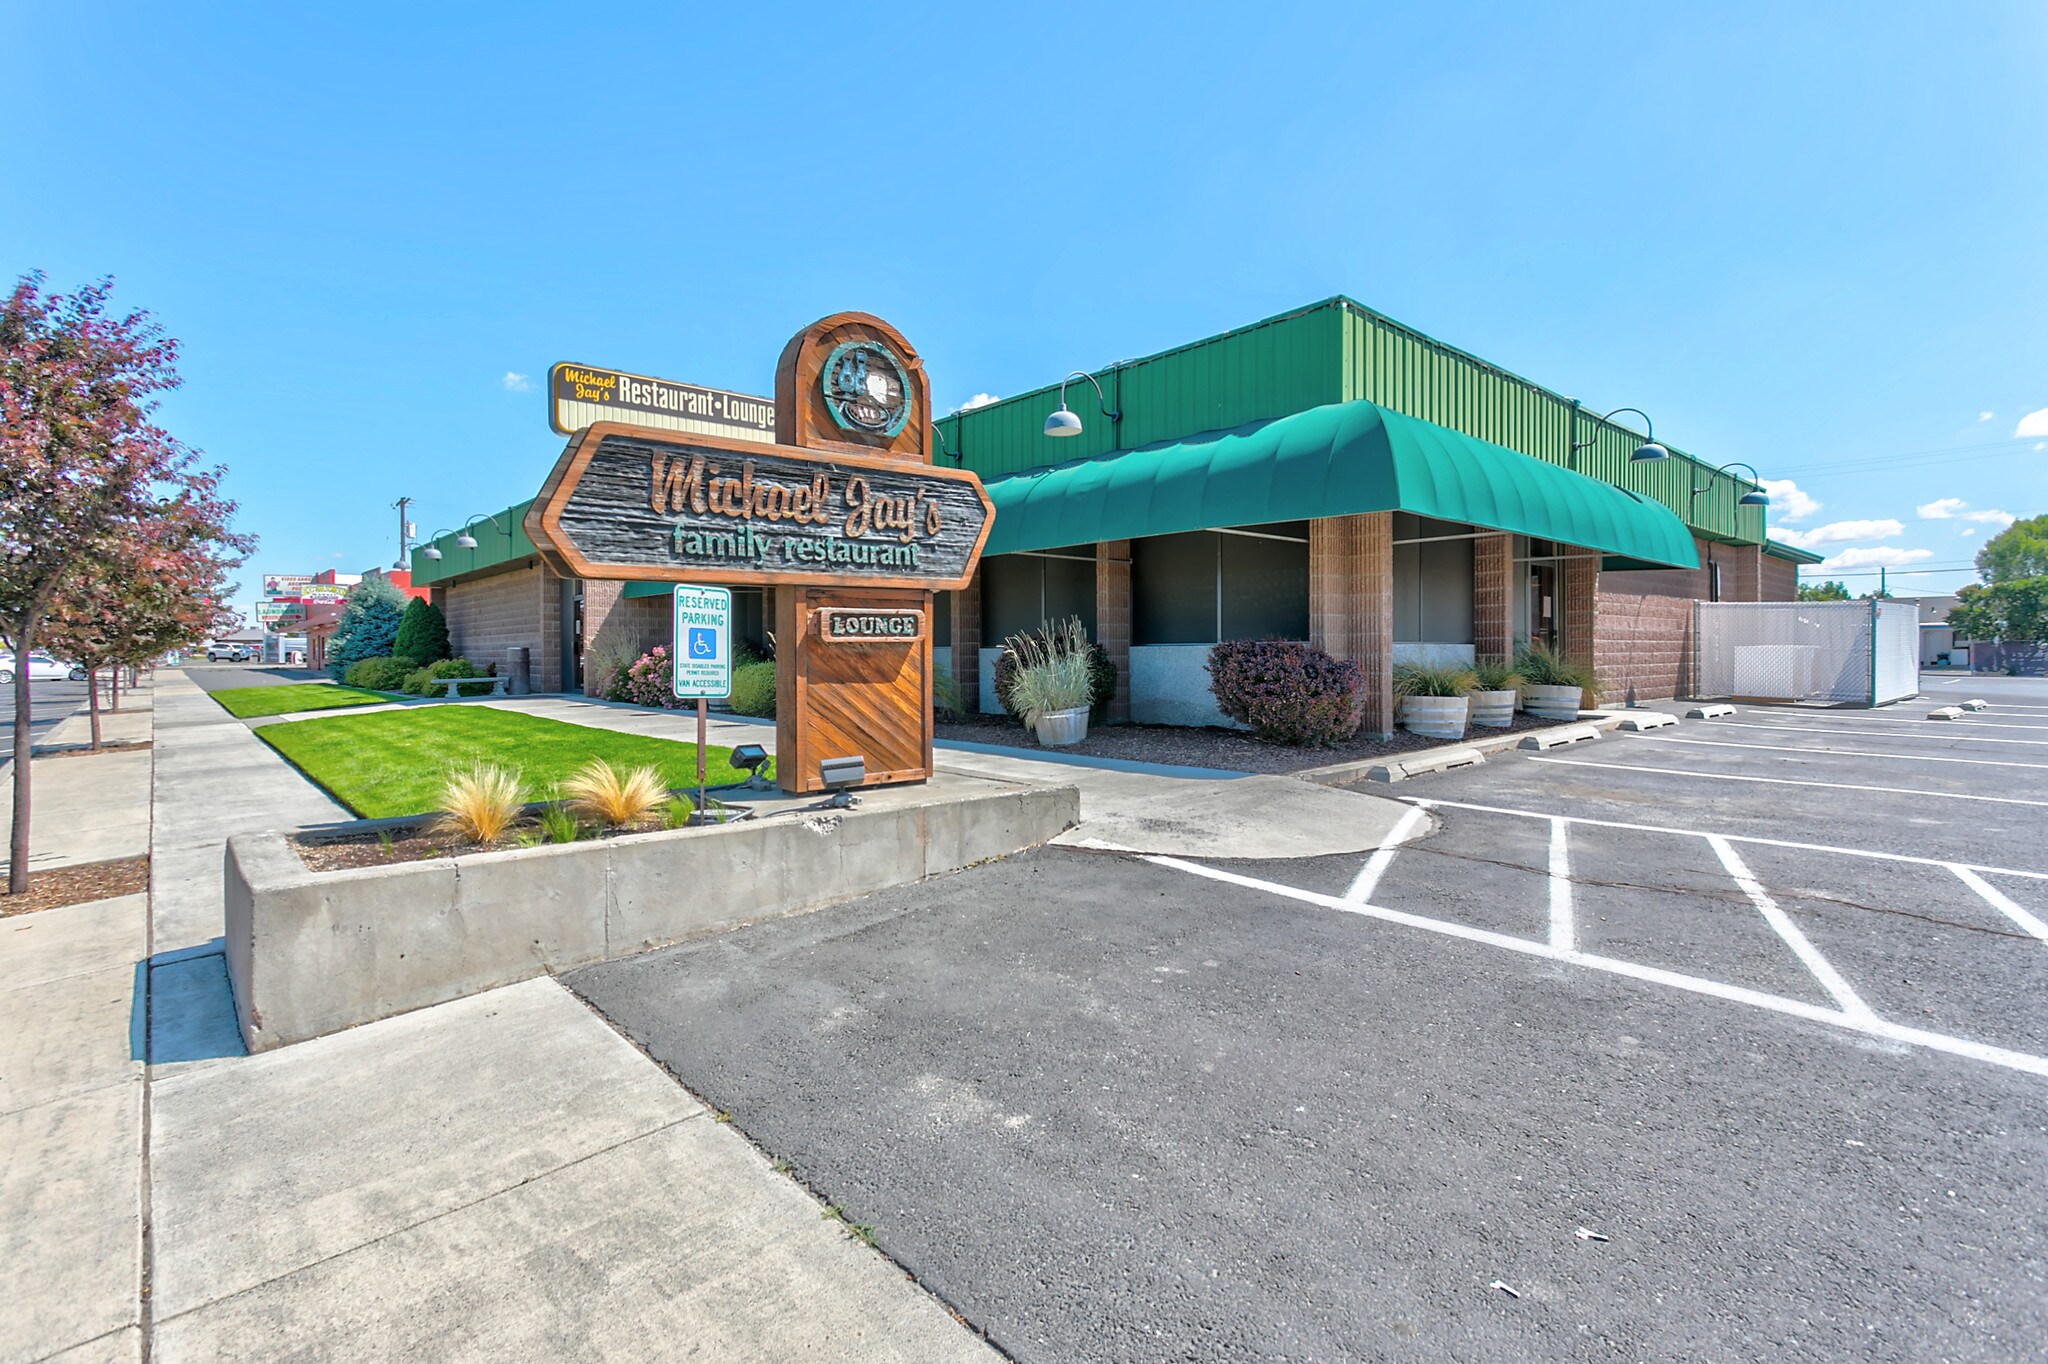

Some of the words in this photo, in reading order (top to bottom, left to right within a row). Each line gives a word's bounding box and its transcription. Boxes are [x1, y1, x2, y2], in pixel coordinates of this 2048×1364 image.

[564, 368, 616, 389] Michael
[575, 382, 610, 402] Jay's
[619, 376, 714, 416] Restaurant
[722, 395, 775, 429] Lounge
[651, 450, 832, 524] Michael
[844, 474, 942, 543] Jay's
[673, 520, 772, 567] family
[784, 535, 920, 567] restaurant
[678, 595, 727, 611] RESERVED
[682, 612, 724, 626] PARKING
[833, 617, 915, 635] LOUNGE
[679, 679, 690, 688] VAN
[692, 680, 727, 688] ACCESSIBLE
